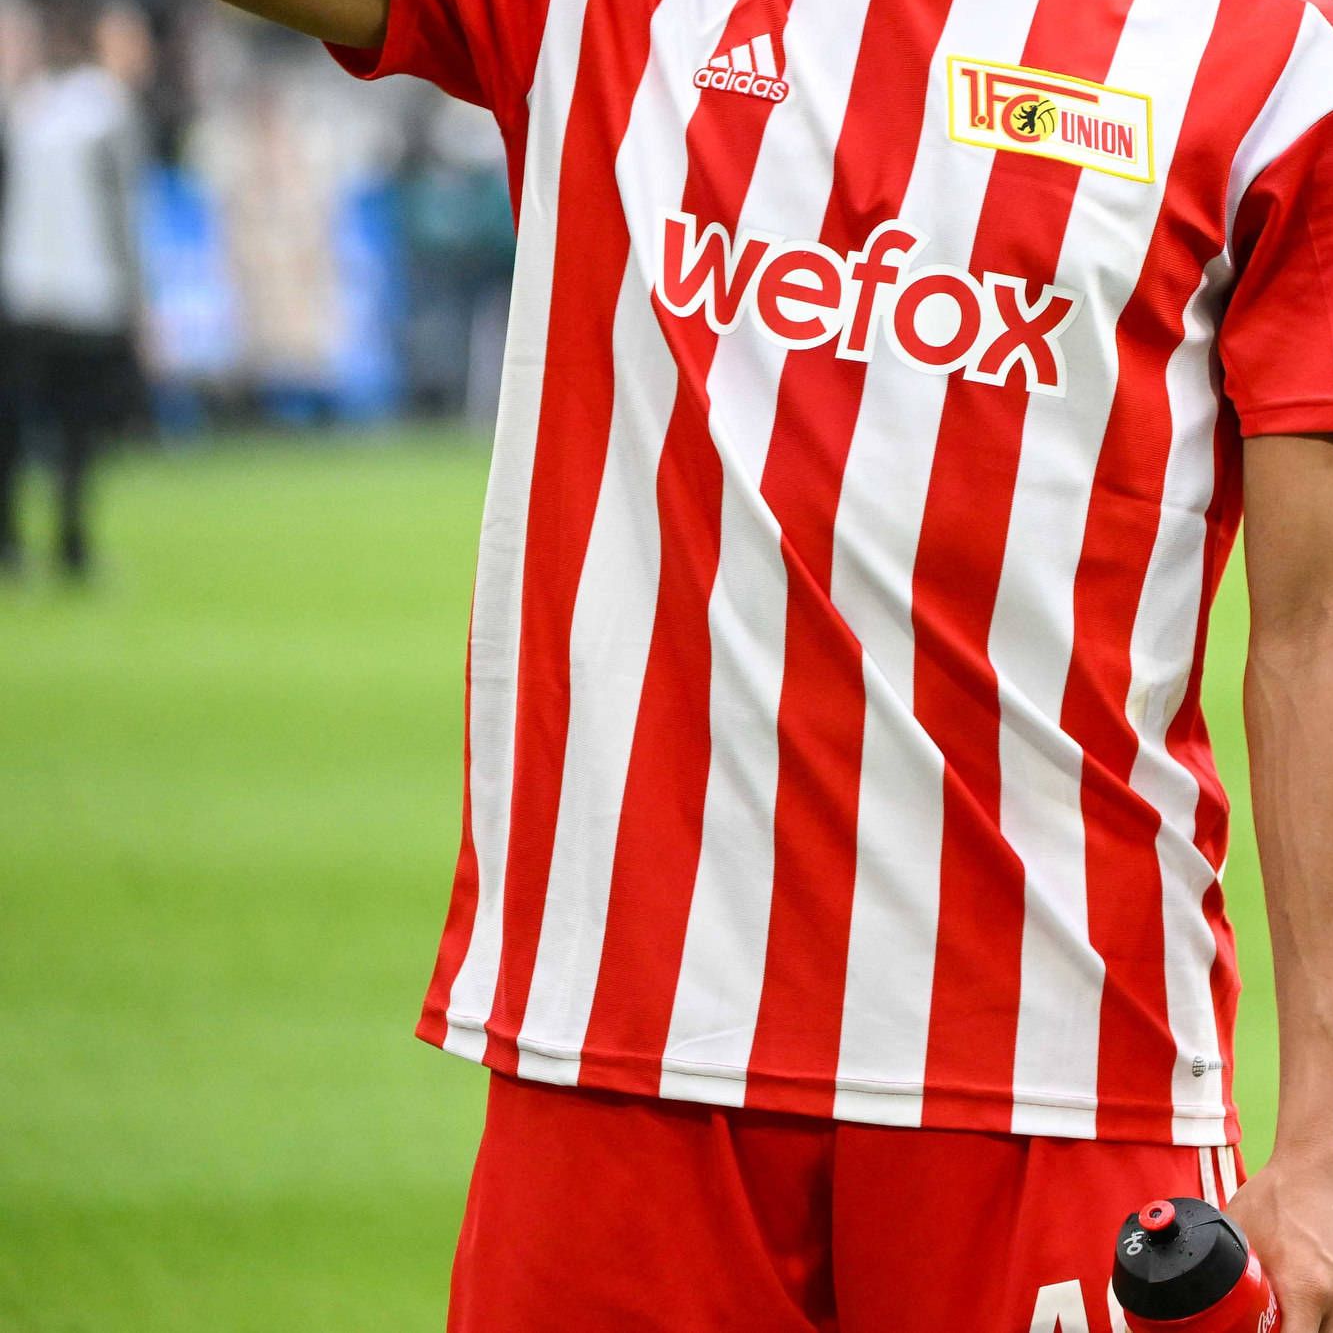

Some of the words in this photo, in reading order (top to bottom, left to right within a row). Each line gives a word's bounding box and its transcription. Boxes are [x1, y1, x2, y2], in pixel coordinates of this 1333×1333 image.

[694, 66, 787, 102] adidas
[1061, 111, 1133, 158] UNION
[660, 215, 1074, 389] wefox
